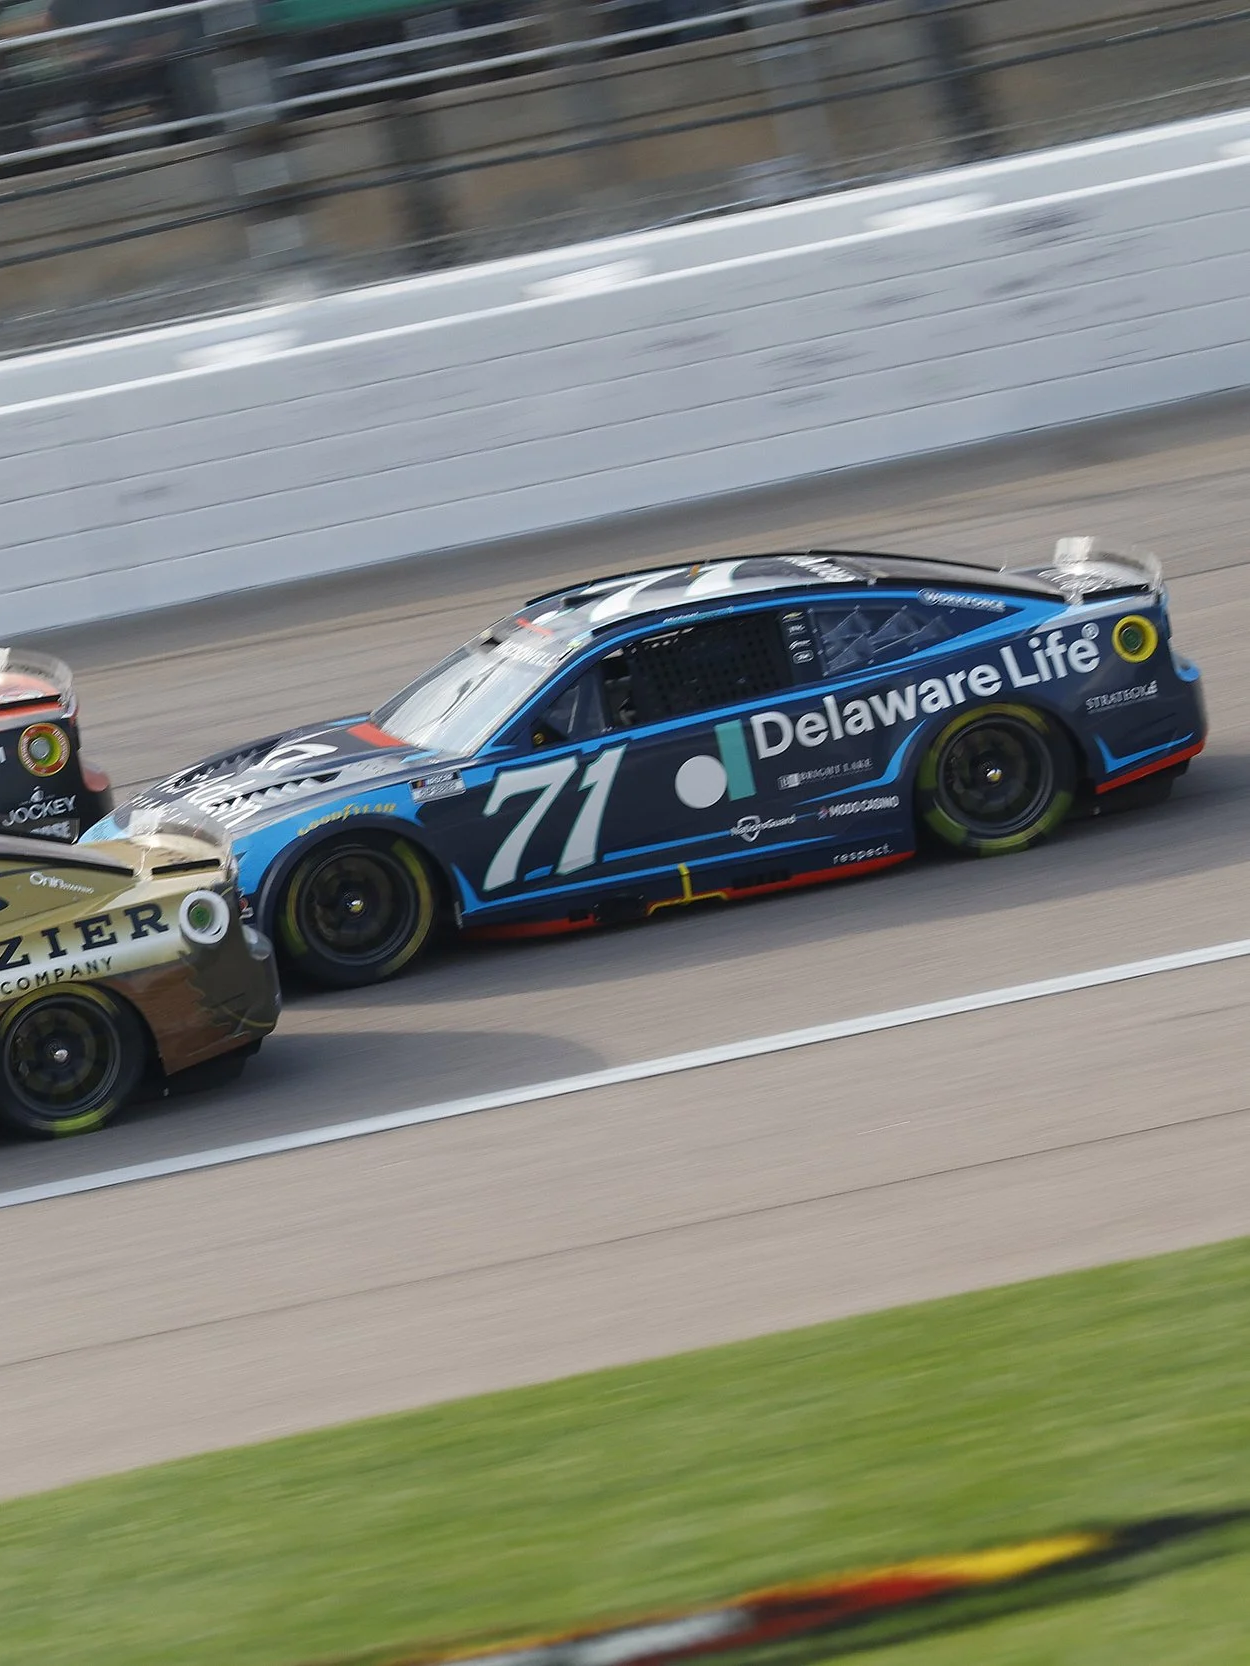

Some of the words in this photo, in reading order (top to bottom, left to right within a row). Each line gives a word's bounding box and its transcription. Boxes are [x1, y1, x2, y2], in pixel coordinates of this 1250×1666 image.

[750, 663, 1003, 760] Delaware
[2, 795, 76, 827] JOCKEY
[297, 803, 397, 837] GOODYEAR
[482, 745, 627, 893] 71
[0, 956, 114, 994] COMPANY
